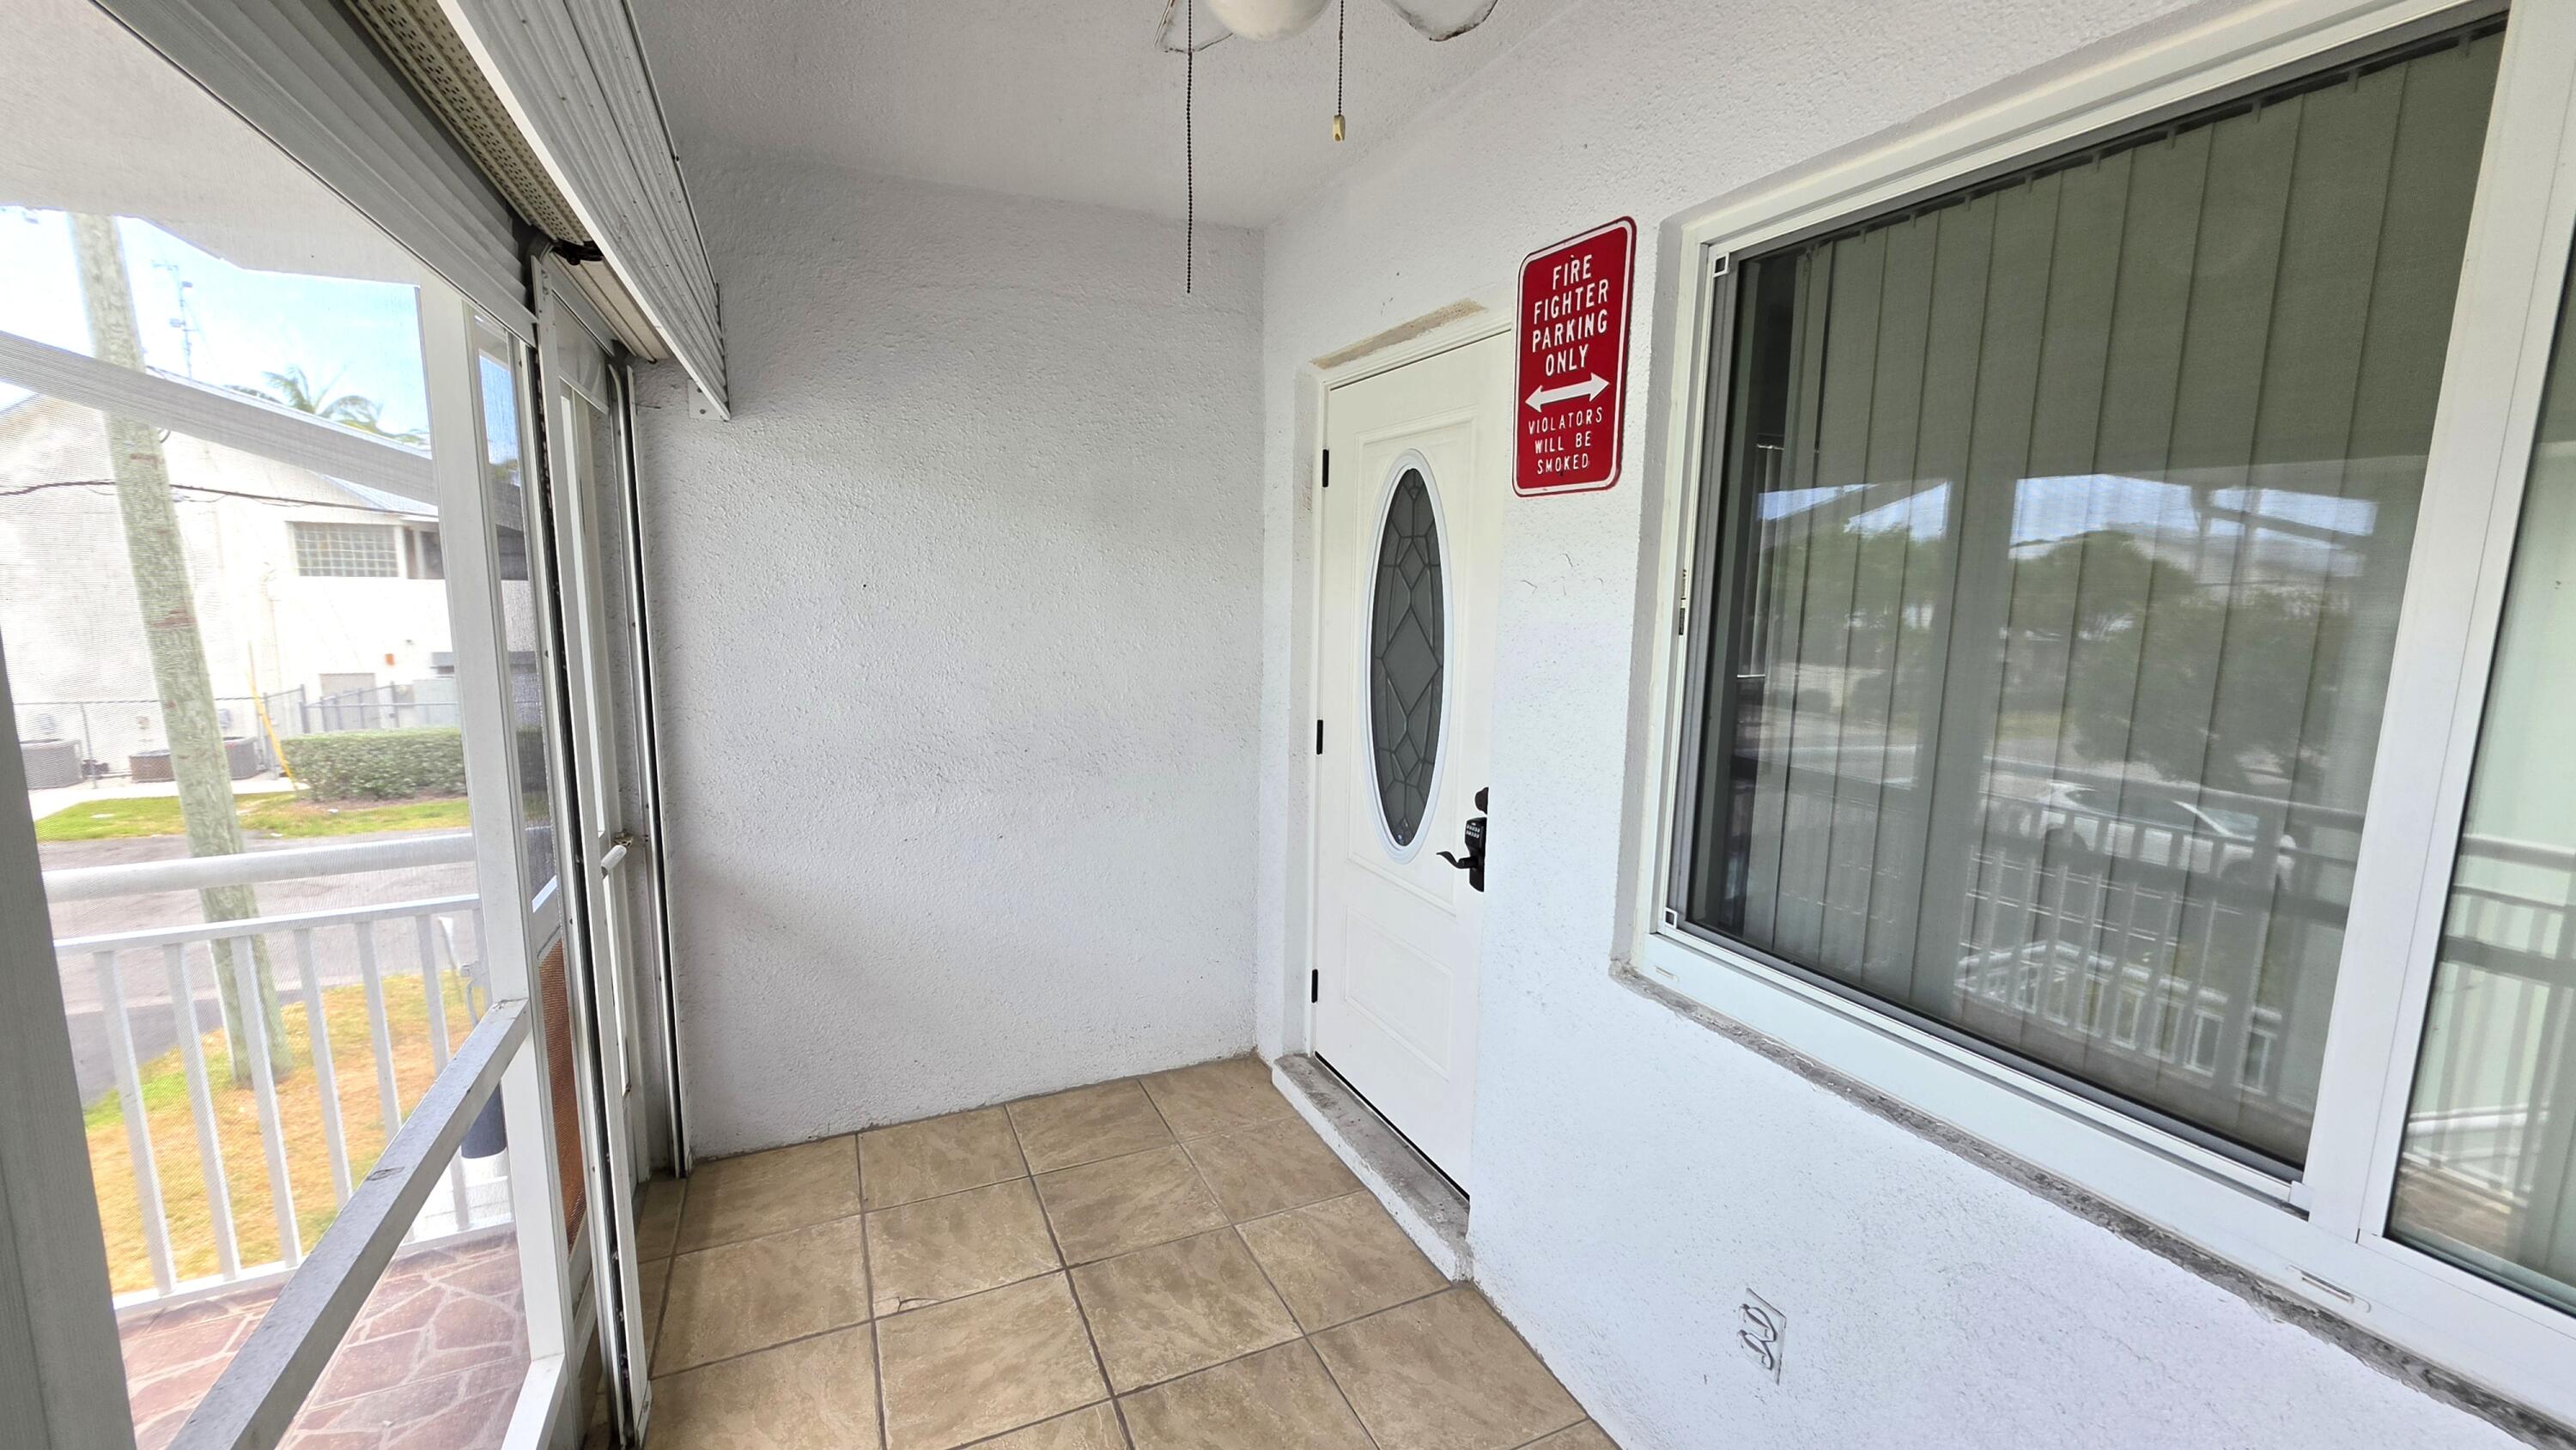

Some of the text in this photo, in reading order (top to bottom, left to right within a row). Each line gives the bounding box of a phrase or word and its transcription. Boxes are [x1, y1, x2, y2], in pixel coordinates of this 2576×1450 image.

[1552, 254, 1593, 290] FIRE
[1534, 279, 1609, 325] FIGHTER
[1532, 309, 1607, 353] PARKING
[1546, 343, 1589, 377] ONLY
[1528, 406, 1602, 435] VIOLATORS
[1534, 431, 1592, 454] WILL BE
[1537, 453, 1589, 475] SMOKED
